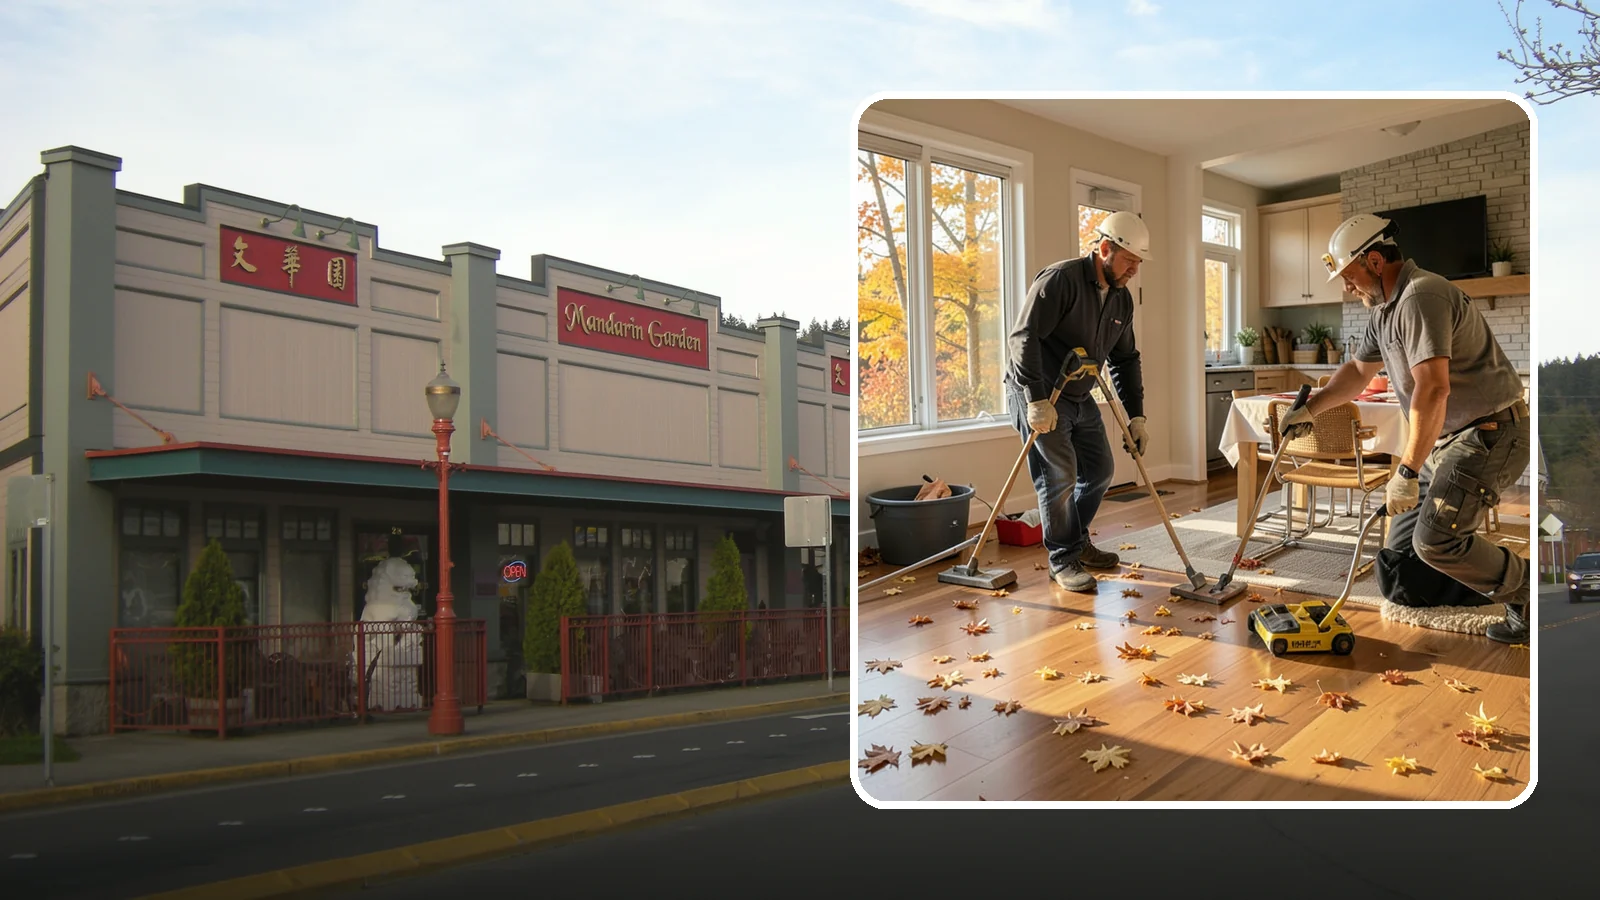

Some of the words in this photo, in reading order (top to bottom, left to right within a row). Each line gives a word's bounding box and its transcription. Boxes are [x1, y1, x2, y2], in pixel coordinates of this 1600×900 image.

[231, 235, 346, 291] 文華園
[564, 302, 644, 342] Mandarin
[648, 320, 701, 352] Garden
[503, 565, 527, 578] OPEN
